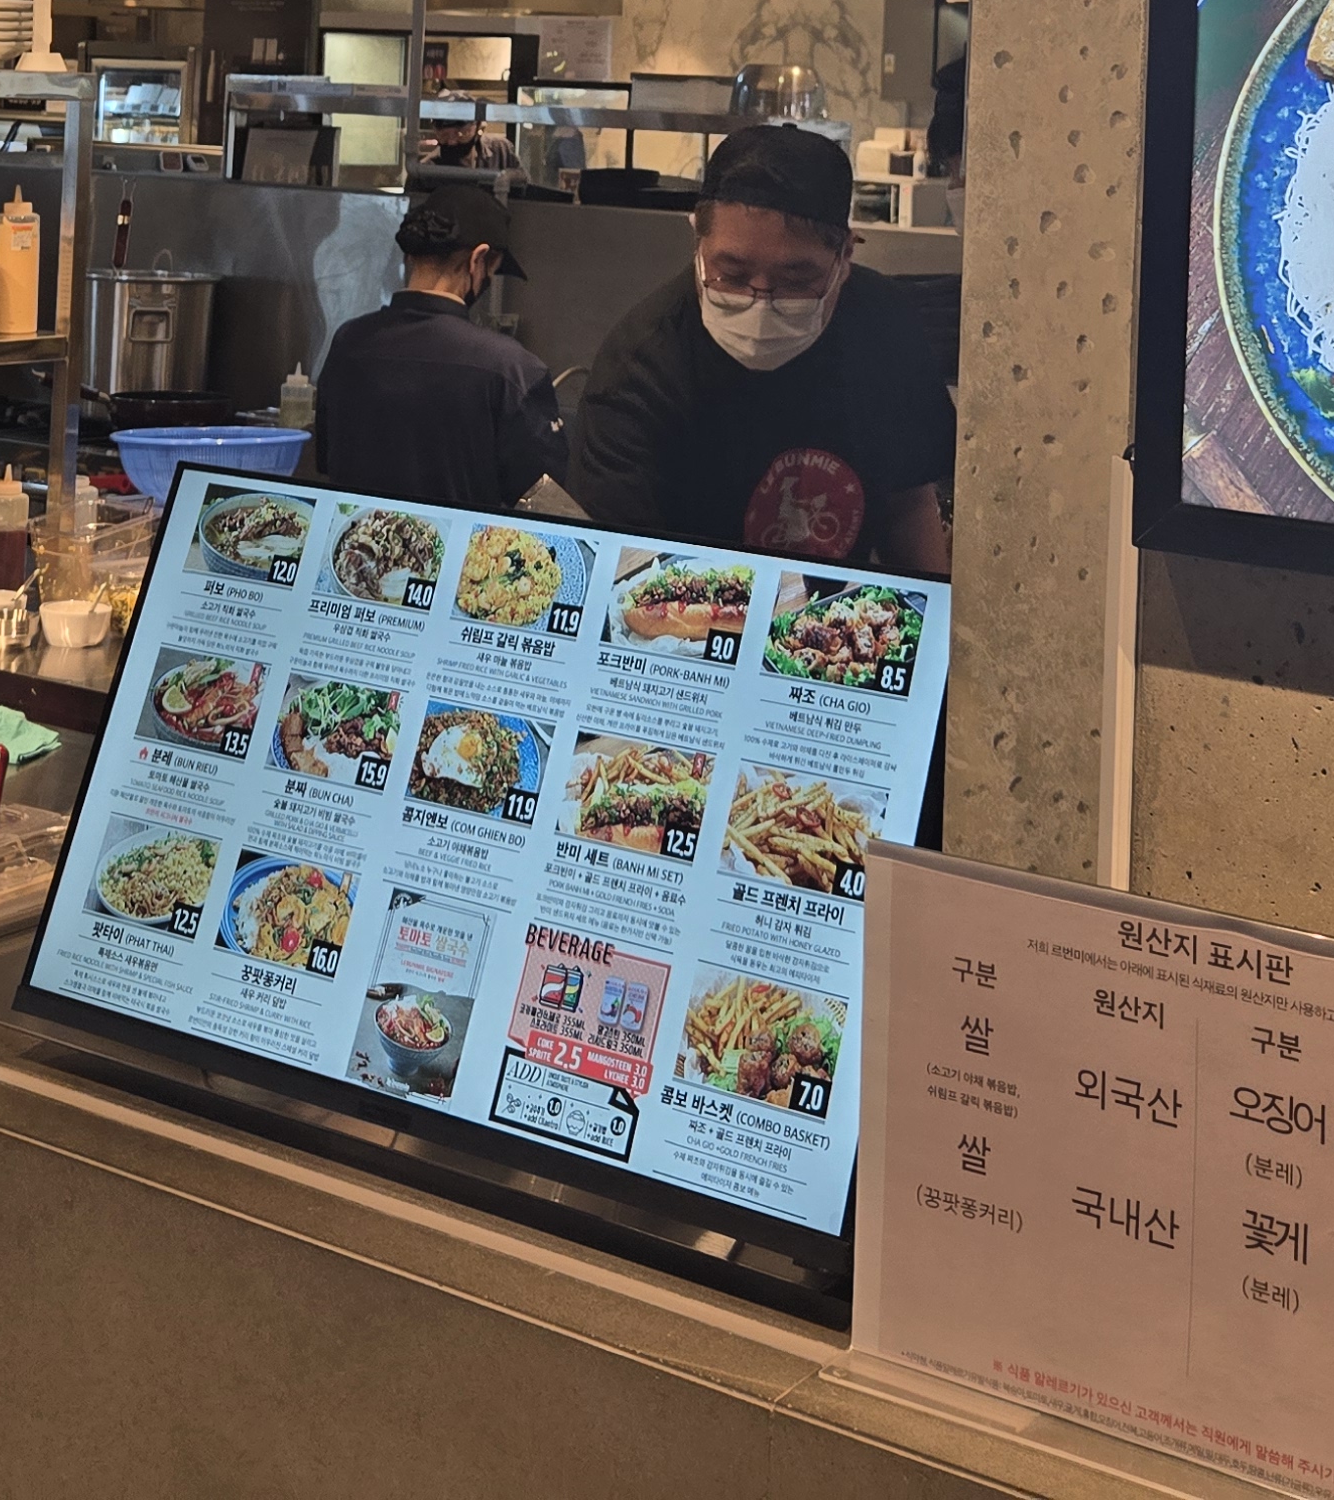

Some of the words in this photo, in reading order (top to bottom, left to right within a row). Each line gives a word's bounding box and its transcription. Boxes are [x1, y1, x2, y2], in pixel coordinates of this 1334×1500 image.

[270, 559, 297, 583] 12.0
[203, 579, 225, 596] 퍼보
[225, 586, 246, 600] (PHO
[245, 590, 263, 604] BO)
[404, 582, 433, 607] 14.0
[307, 598, 352, 619] 프리미엄
[353, 606, 376, 624] 퍼보
[377, 614, 425, 632] (PREMIUM)
[549, 607, 580, 634] 11.9
[460, 626, 494, 646] 쉬림프
[495, 632, 519, 650] 갈릭
[520, 637, 556, 657] 볶음밥
[709, 634, 734, 661] 9.0
[596, 652, 646, 674] 포크반미
[648, 664, 712, 684] (PORK-BANH
[713, 674, 730, 689] MI)
[879, 665, 906, 691] 8.5
[788, 685, 816, 705] 짜조
[818, 695, 845, 710] (CHA
[846, 700, 871, 715] GIO)
[788, 711, 823, 727] 베트남식
[843, 721, 862, 734] 만두
[221, 731, 249, 755] 13.5
[150, 748, 173, 766] 분레
[173, 756, 195, 771] (BUN
[194, 761, 218, 776] RIEU)
[358, 760, 387, 786] 15.9
[283, 778, 307, 797] 분짜
[307, 787, 331, 803] (BUN
[331, 792, 354, 808] CHA)
[505, 793, 536, 820] 11.9
[401, 806, 449, 830] 콤지엔보
[450, 820, 476, 837] (COM
[477, 826, 507, 843] GHIEN
[507, 833, 526, 848] BO)
[664, 828, 696, 857] 12.5
[555, 841, 582, 862] 반미
[583, 847, 610, 868] 세트
[611, 857, 645, 876] (BANH
[647, 865, 659, 879] MI
[660, 868, 684, 886] SET)
[839, 868, 866, 896] 4.0
[732, 882, 760, 904] 골드
[761, 889, 801, 914] 프렌치
[802, 899, 844, 924] 프라이
[171, 908, 199, 934] 12.5
[91, 921, 124, 943] 팟타이
[124, 933, 151, 950] (PHAT
[151, 941, 174, 957] THAI)
[397, 926, 432, 947] 토마토
[434, 935, 470, 957] 쌀국수
[525, 925, 615, 963] BEVERAGE
[1117, 920, 1196, 963] 원산지
[1208, 940, 1294, 985] 표시판
[308, 946, 337, 973] 16.0
[951, 956, 997, 989] 구분
[1027, 938, 1049, 957] 저희
[1050, 944, 1117, 972] 르번미에서는
[1119, 959, 1153, 980] 아래에
[1156, 967, 1190, 989] 표시된
[1192, 977, 1238, 1001] 식재료의
[1239, 988, 1287, 1012] 원산지만
[239, 965, 297, 993] 꿍팟퐁커리
[1092, 988, 1166, 1029] 원산지
[959, 1013, 994, 1057] 쌀
[1250, 1026, 1302, 1062] 구분
[506, 1060, 542, 1084] ADD
[553, 1042, 582, 1070] 2.5
[633, 1064, 647, 1076] 3.0
[630, 1076, 645, 1089] 3.0
[797, 1080, 824, 1112] 7.0
[926, 1062, 962, 1084] (소고기
[963, 1070, 983, 1089] 야채
[986, 1076, 1021, 1099] 볶음밥,
[927, 1084, 958, 1103] 쉬림프
[960, 1091, 982, 1109] 갈릭
[983, 1098, 1019, 1119] 볶음밥)
[1074, 1069, 1183, 1128] 외국산
[1228, 1085, 1327, 1144] 오징어
[659, 1085, 688, 1109] 콤보
[691, 1094, 733, 1122] 바스켓
[735, 1111, 781, 1135] (COMBO
[782, 1125, 830, 1150] BASKET)
[957, 1131, 991, 1176] 쌀
[1245, 1153, 1303, 1188] (분레)
[916, 1185, 1023, 1232] (꿍팟퐁커리)
[1071, 1187, 1180, 1248] 국내산
[1242, 1210, 1309, 1264] 꽃게
[1242, 1276, 1300, 1313] (분레)
